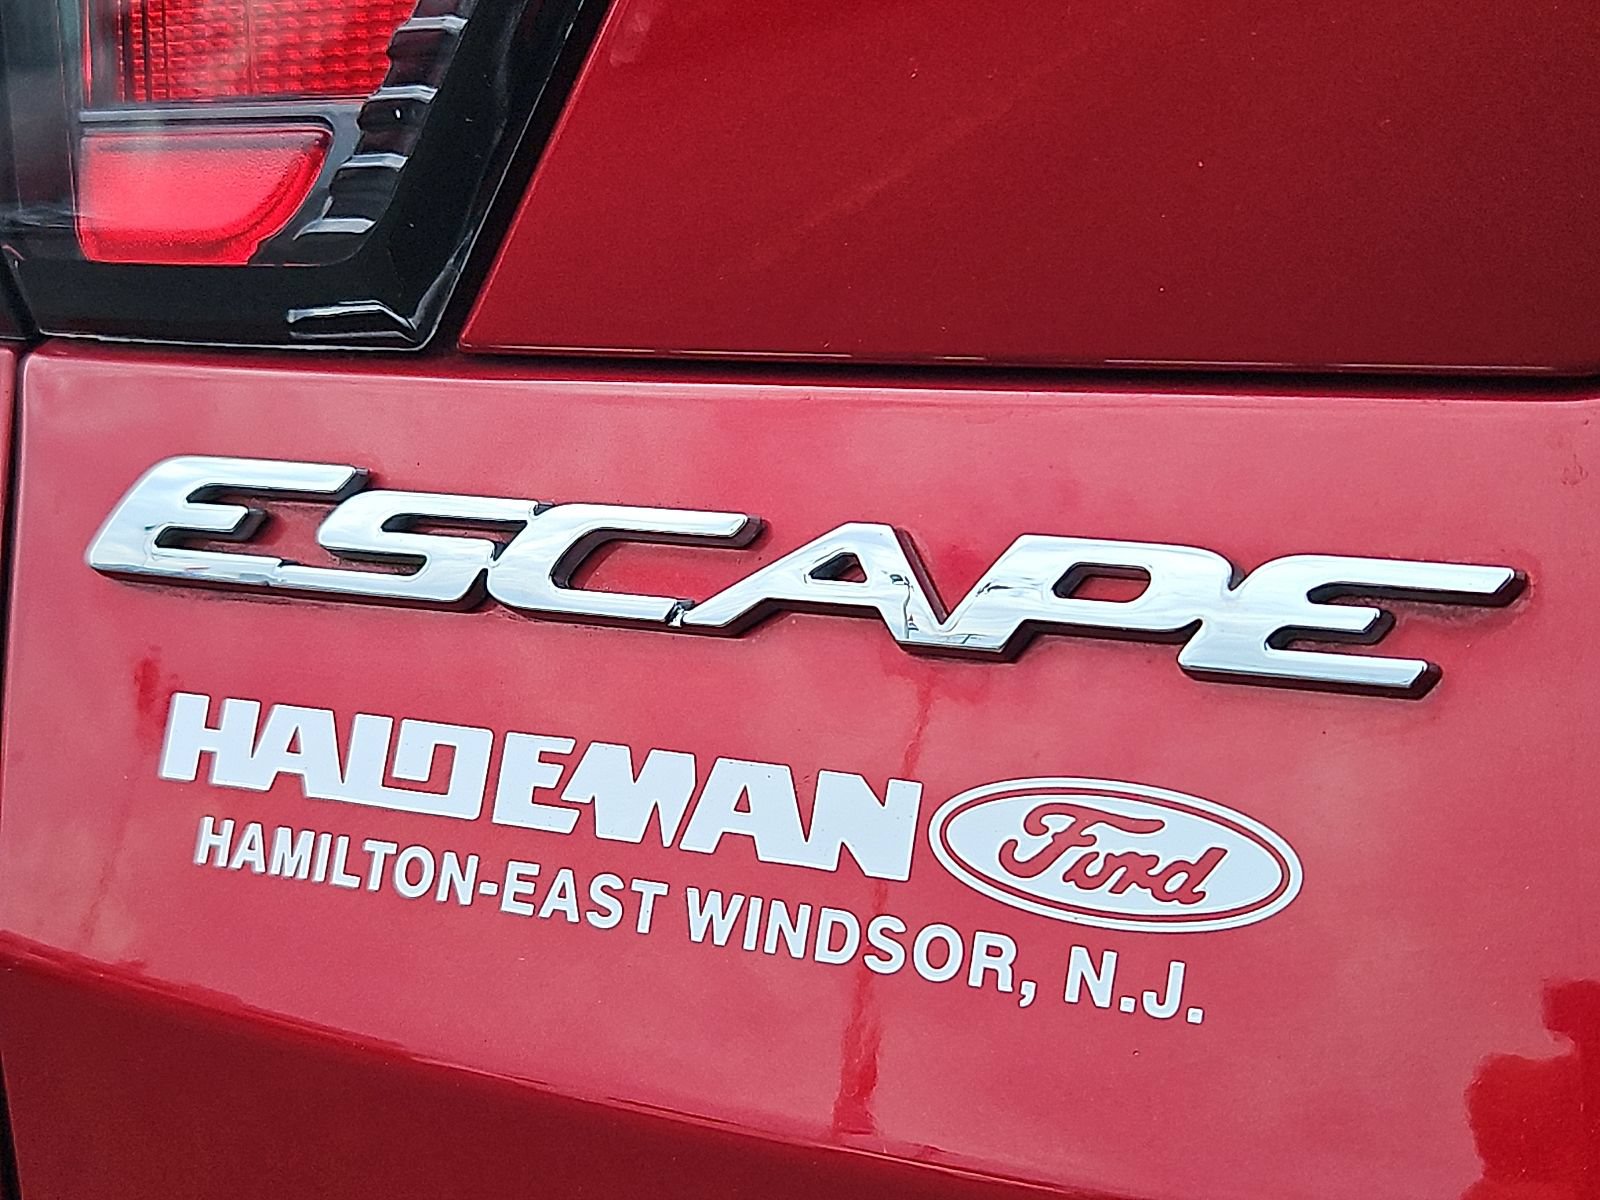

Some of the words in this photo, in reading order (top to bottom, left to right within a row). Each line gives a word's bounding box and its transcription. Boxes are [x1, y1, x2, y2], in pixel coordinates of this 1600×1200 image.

[86, 455, 1520, 694] ESCAPE
[158, 692, 923, 882] HALDEMAN
[999, 802, 1228, 905] Ford
[193, 816, 669, 934] HAMILTON-EAST
[686, 887, 1037, 1007] WINDSOR,
[1064, 945, 1204, 1024] N.J.
